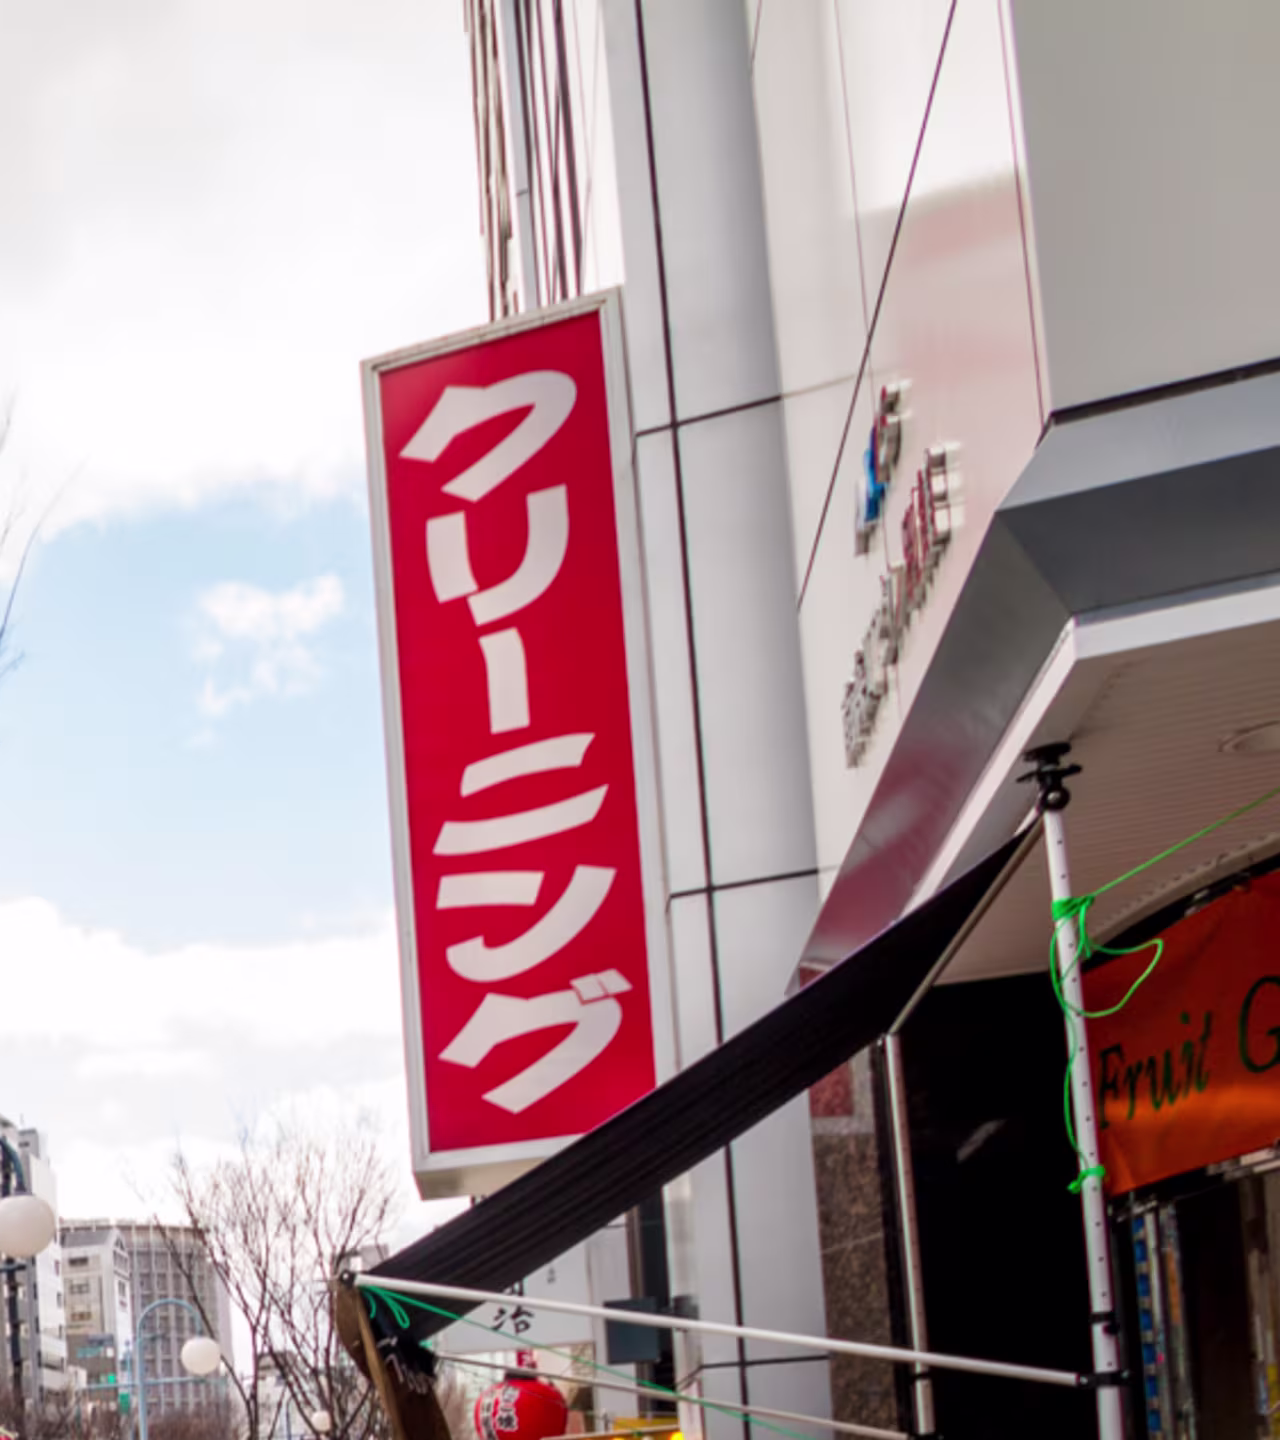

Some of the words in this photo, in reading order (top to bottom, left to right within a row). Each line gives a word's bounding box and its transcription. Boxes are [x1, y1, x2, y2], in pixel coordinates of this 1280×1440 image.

[398, 370, 634, 1115] クリーニング
[1099, 1010, 1212, 1130] Fruit
